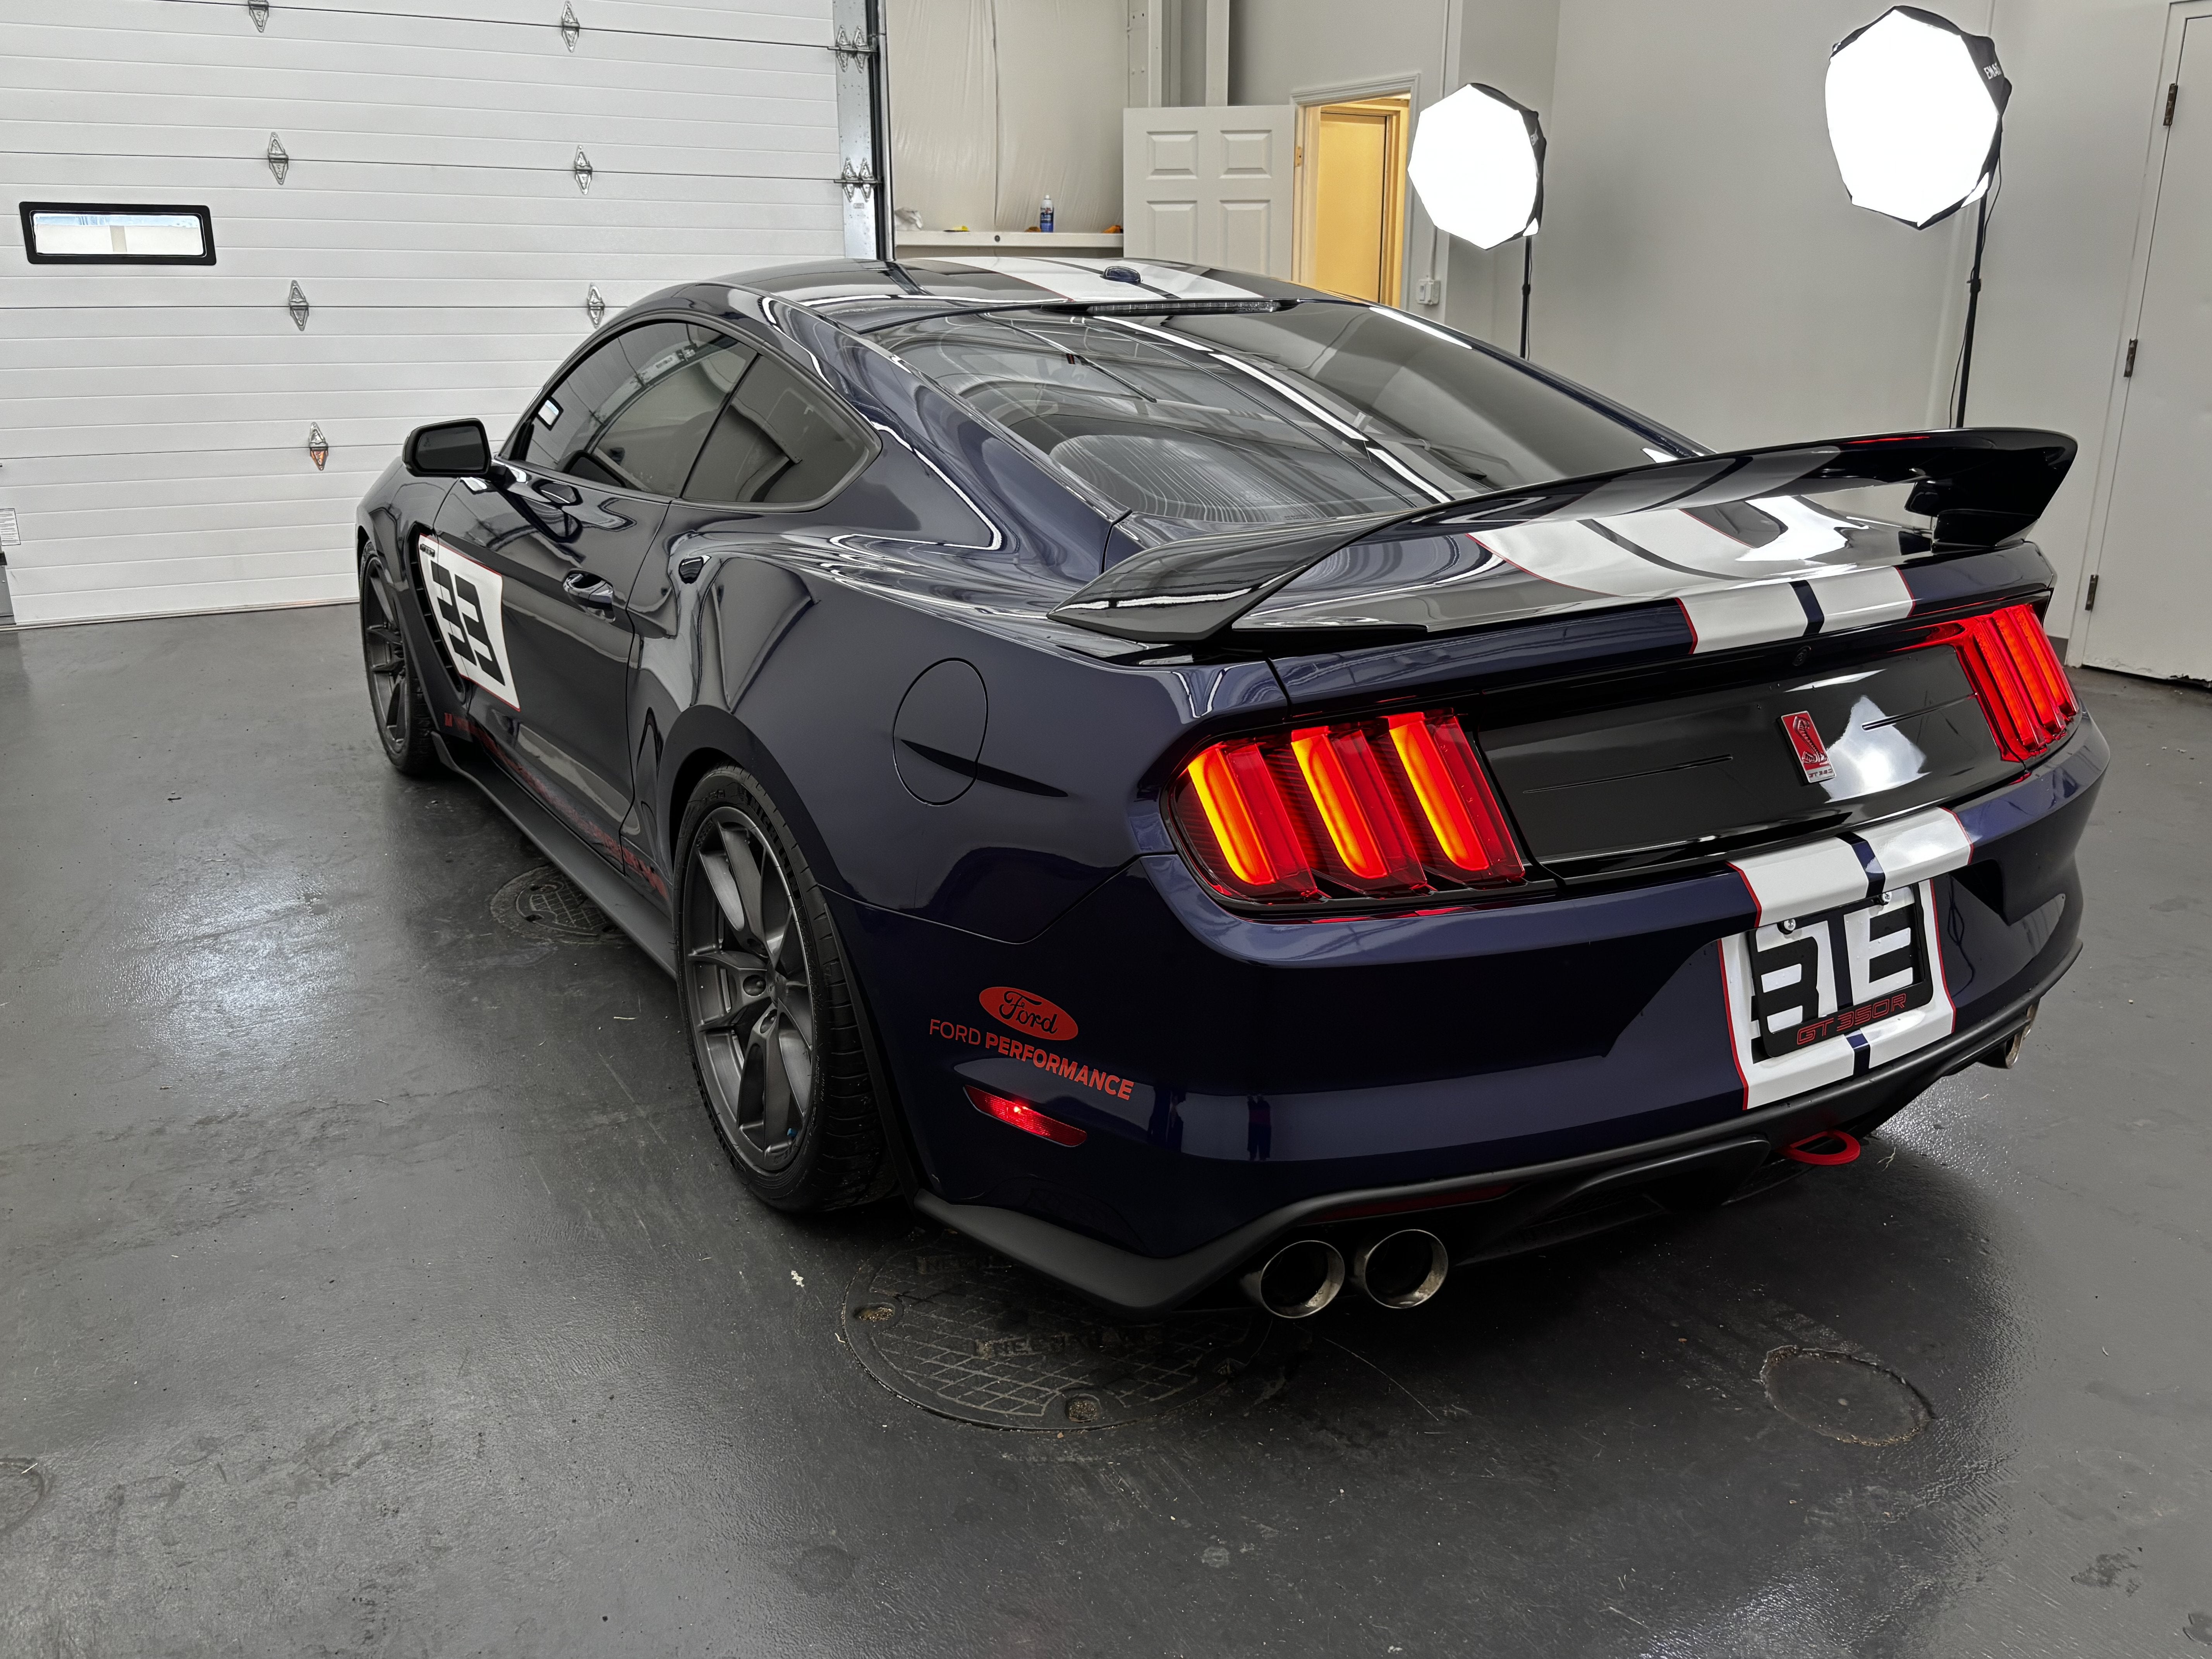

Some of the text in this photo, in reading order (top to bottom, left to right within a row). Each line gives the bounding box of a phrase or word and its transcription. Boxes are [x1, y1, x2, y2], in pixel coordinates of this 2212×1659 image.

[430, 560, 506, 687] 33
[998, 990, 1058, 1034] Ford
[1796, 993, 1907, 1045] GT 350R
[929, 1018, 1134, 1101] FORD PERFORMANCE
